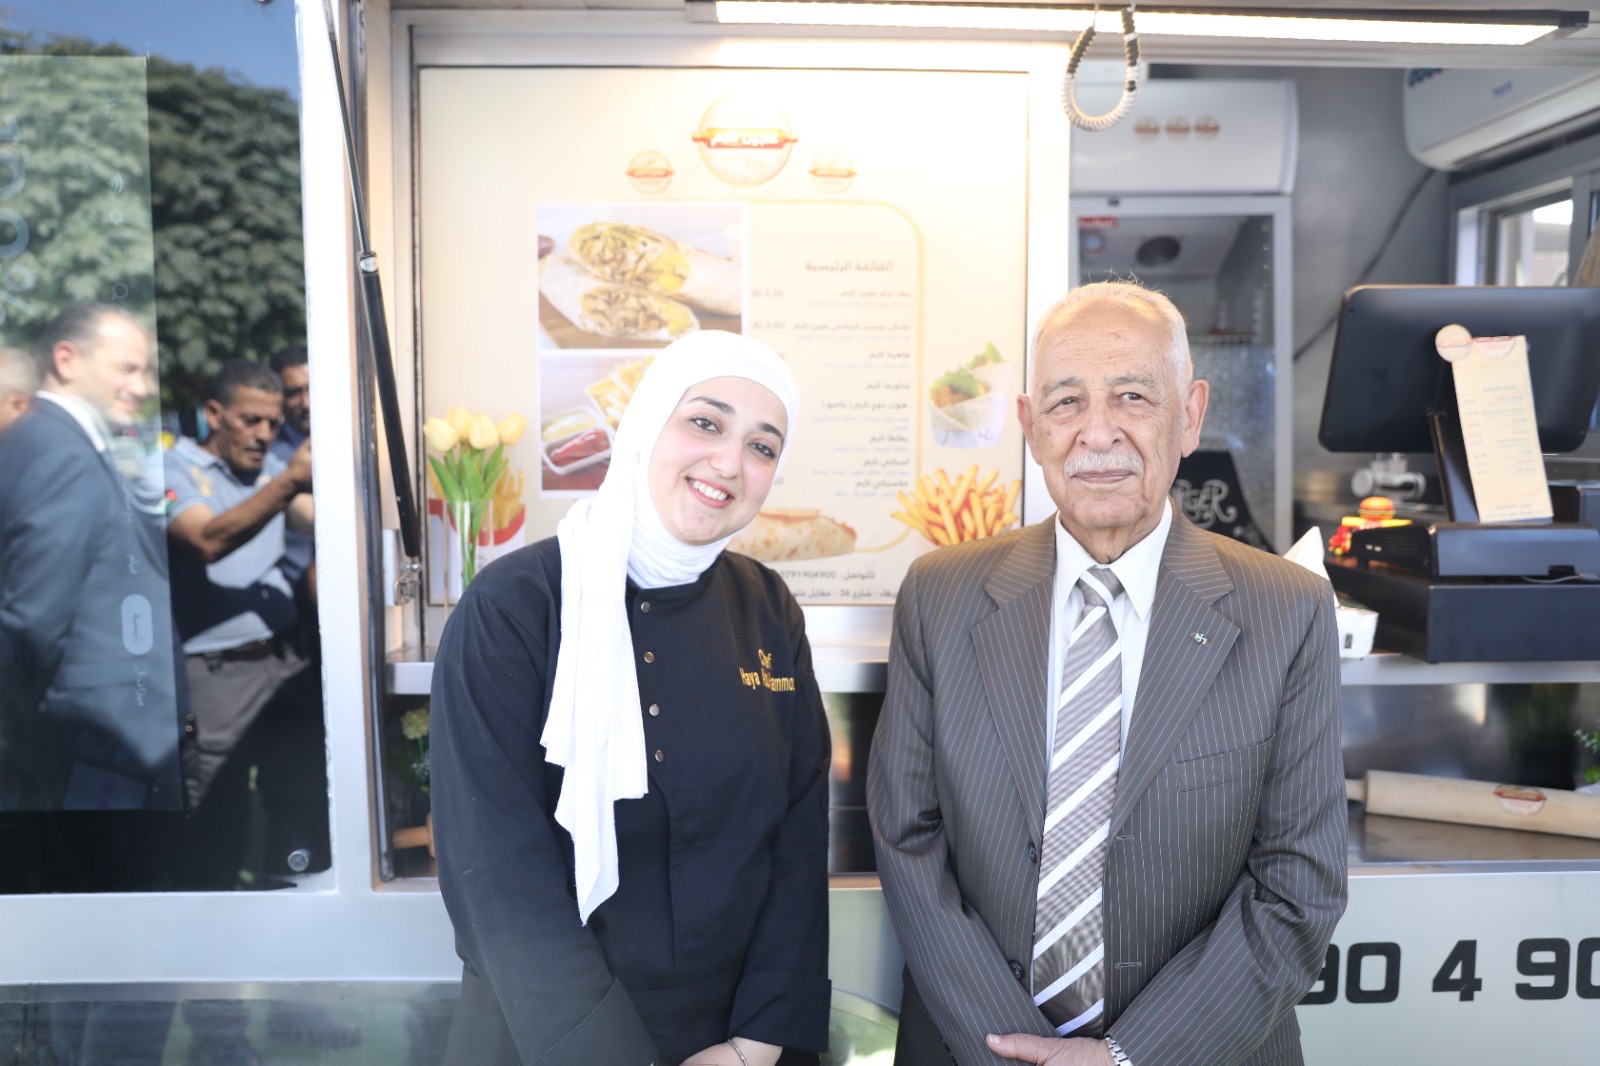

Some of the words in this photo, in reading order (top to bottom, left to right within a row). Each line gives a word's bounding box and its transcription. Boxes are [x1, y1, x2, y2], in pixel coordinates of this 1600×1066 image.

[805, 260, 853, 274] الرئيسية
[855, 260, 894, 272] القائمة
[843, 570, 876, 581] للتواصل
[1432, 939, 1483, 1002] 4
